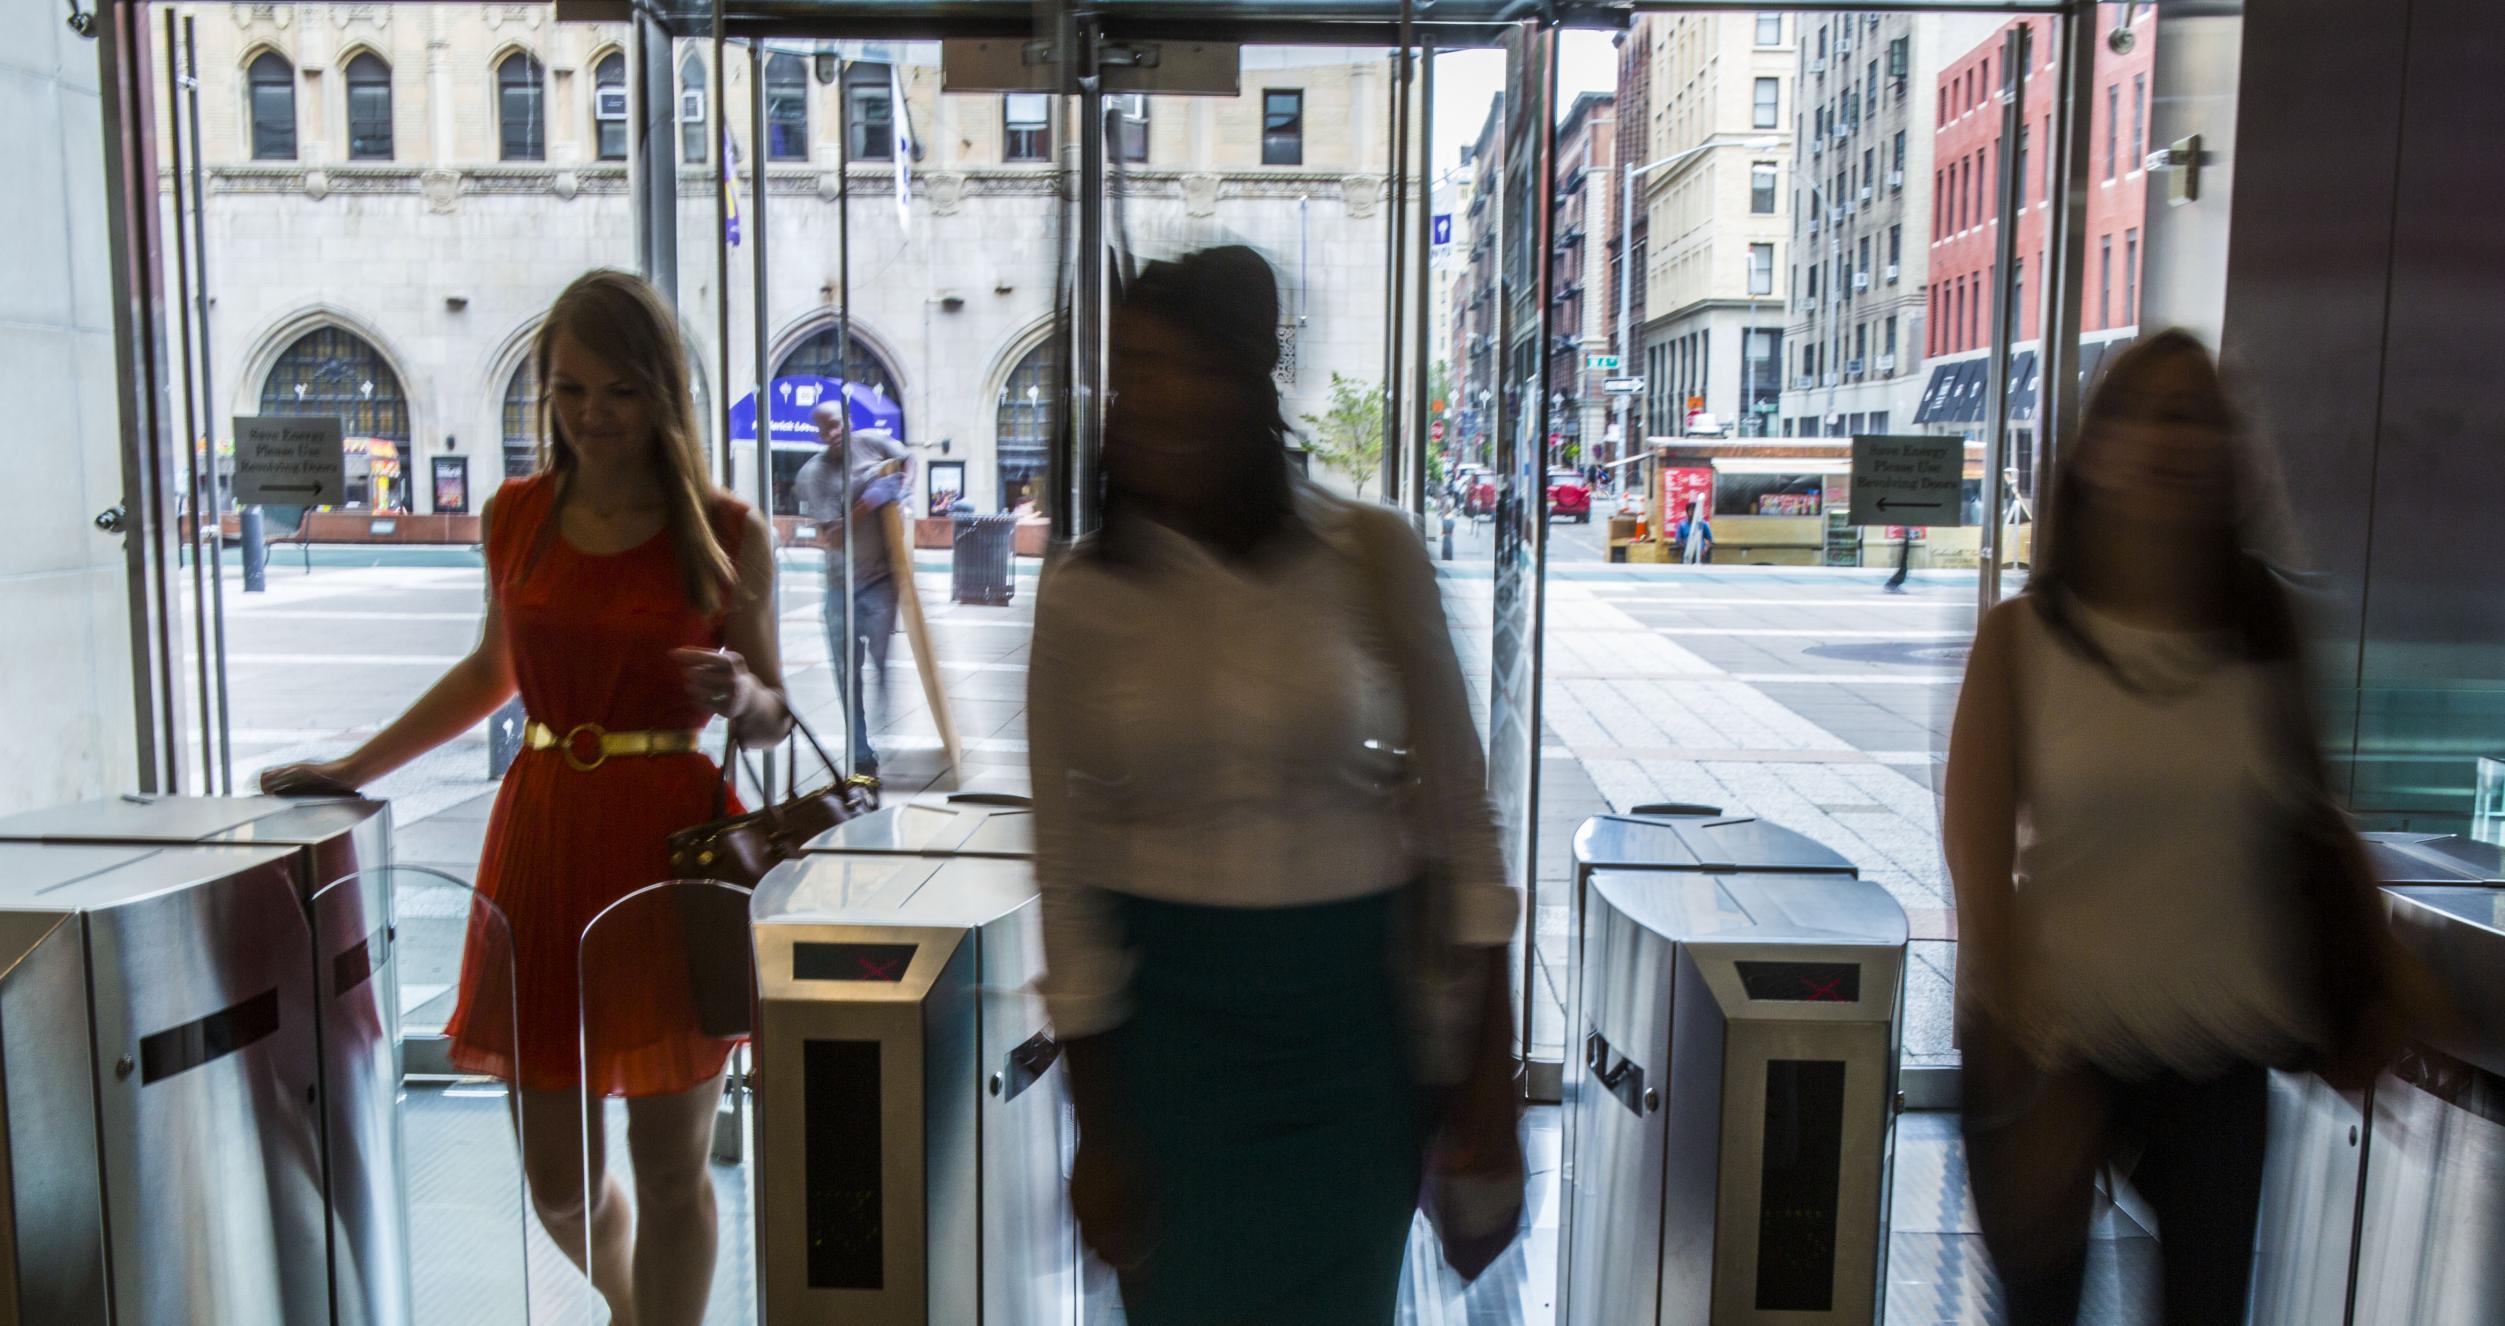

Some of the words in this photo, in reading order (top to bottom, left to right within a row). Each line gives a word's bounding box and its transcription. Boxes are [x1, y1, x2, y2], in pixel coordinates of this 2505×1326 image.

[249, 428, 279, 440] Save
[282, 427, 326, 442] Energy
[256, 443, 294, 456] Please
[298, 443, 320, 457] Use
[1868, 444, 1898, 456] Save
[1903, 444, 1949, 459] Energy
[240, 460, 299, 475] Revolving
[302, 461, 338, 473] Doors
[1873, 460, 1915, 473] Please
[1918, 461, 1941, 473] Use
[1857, 477, 1918, 491] Revolving
[1921, 477, 1958, 489] Doors
